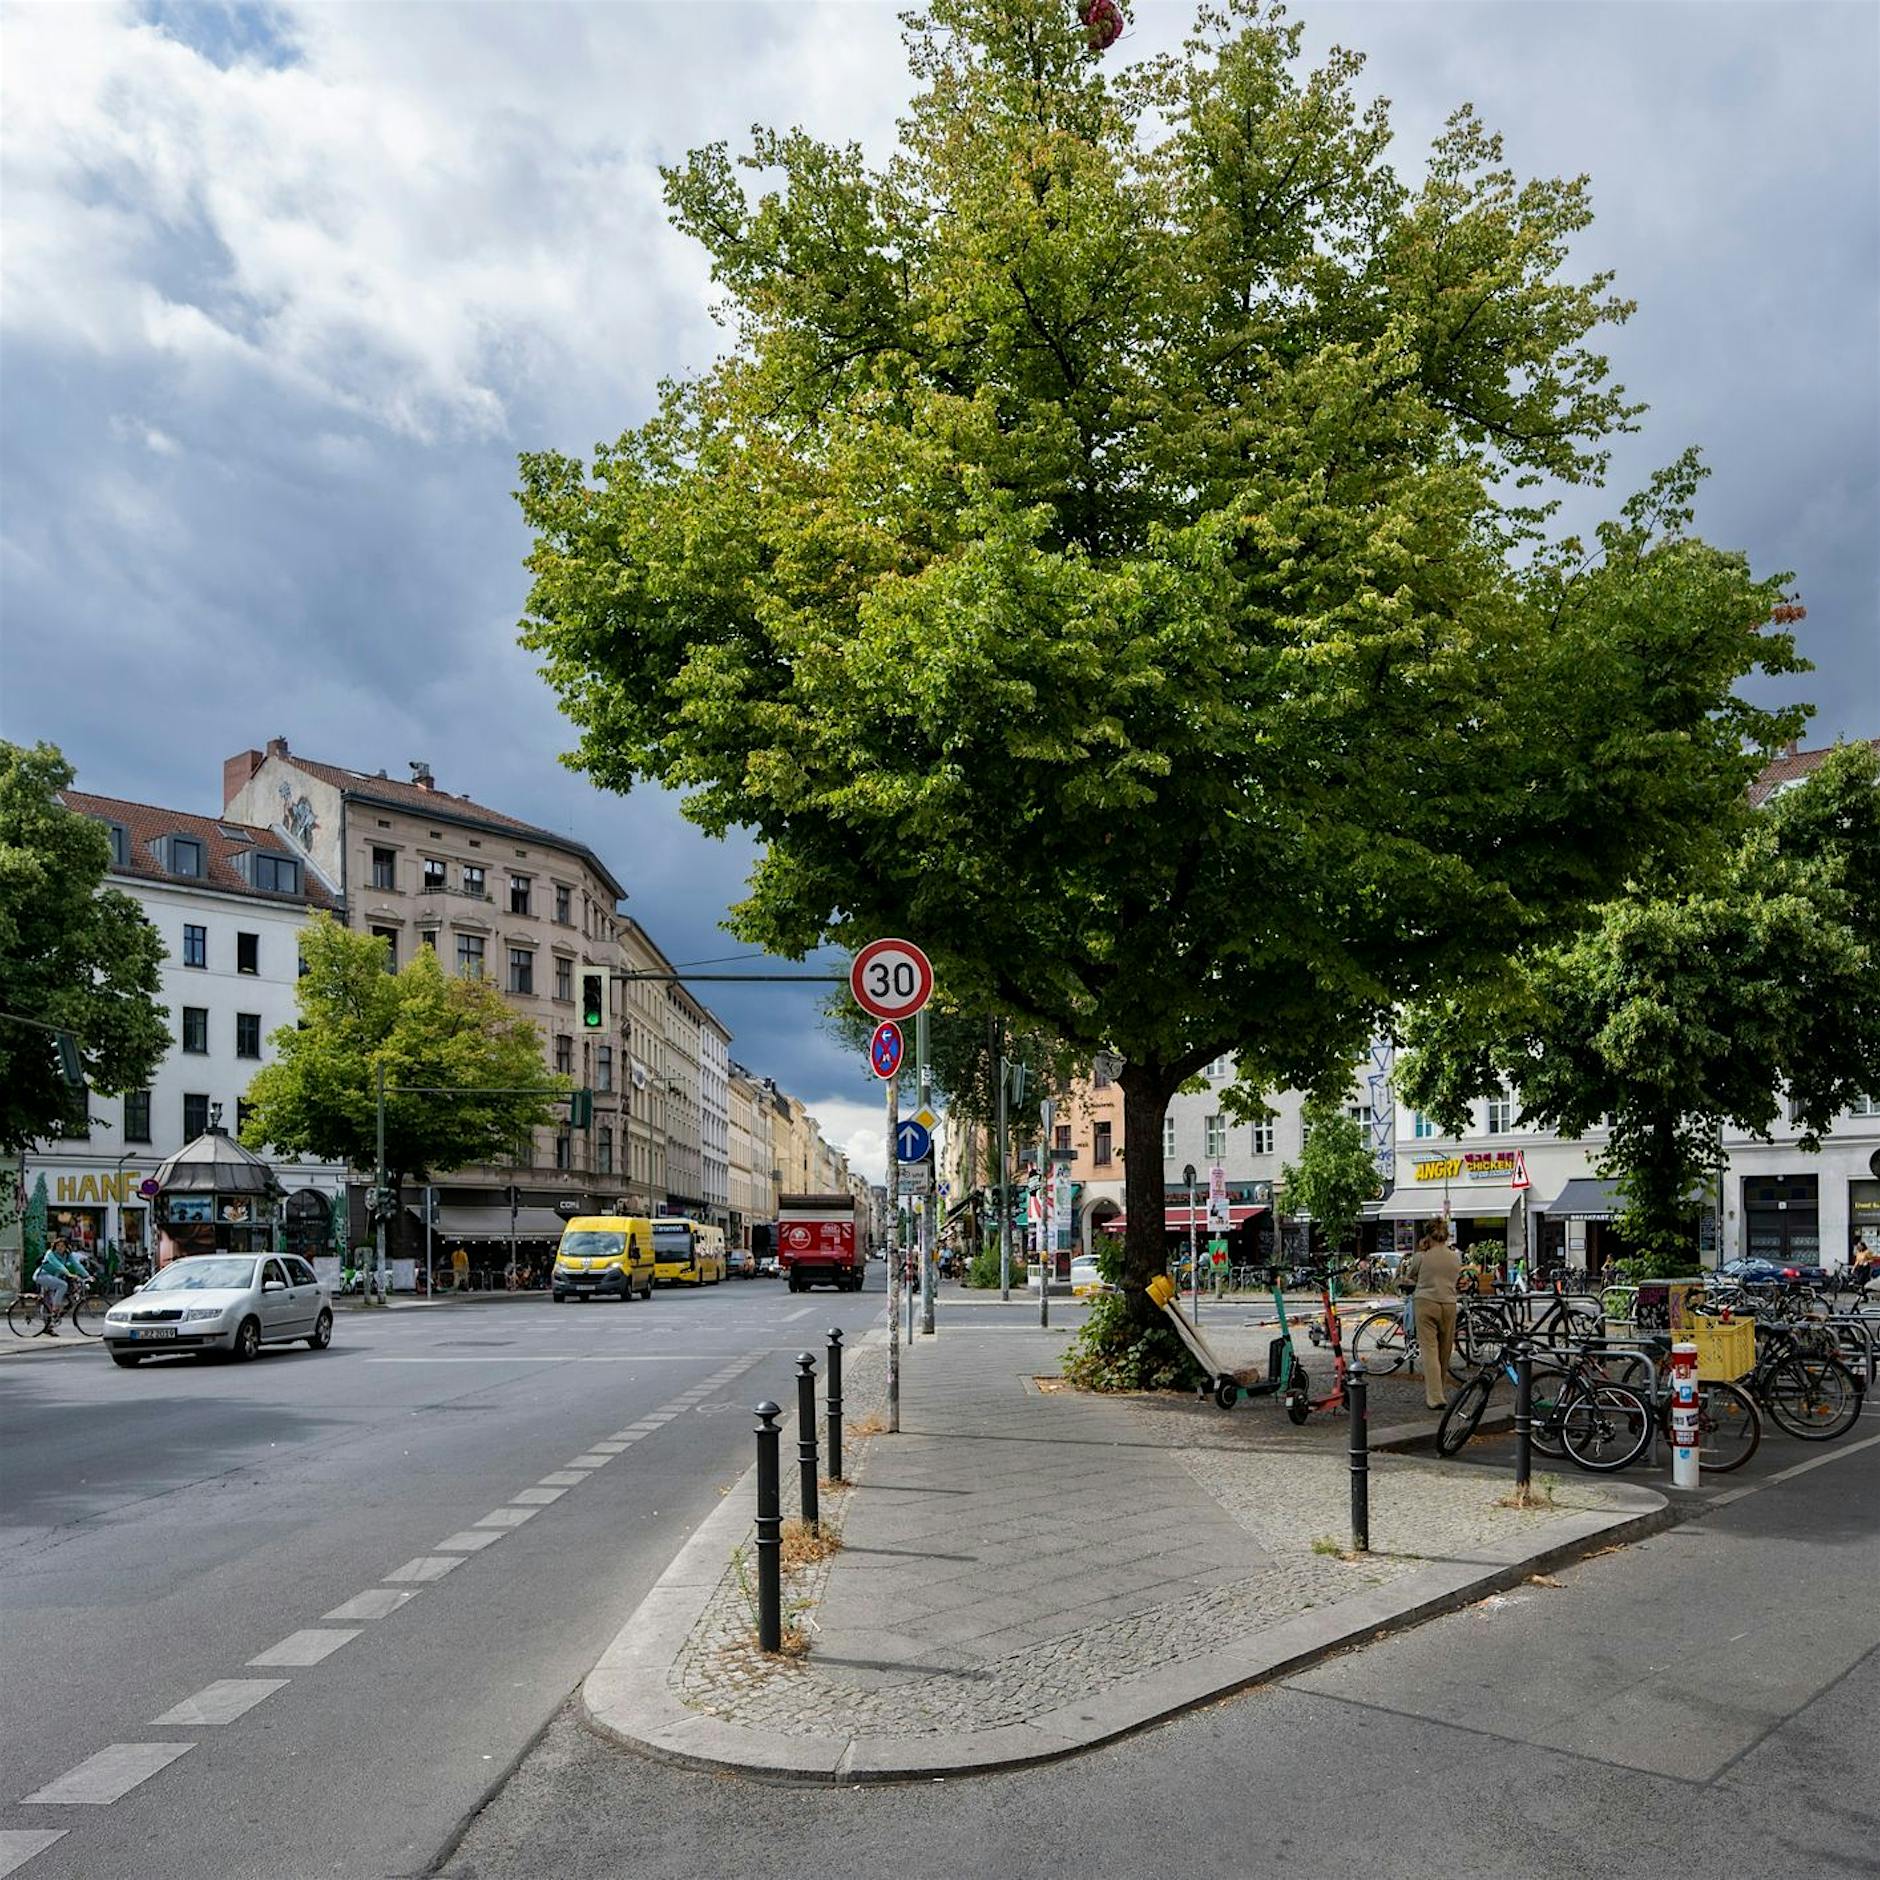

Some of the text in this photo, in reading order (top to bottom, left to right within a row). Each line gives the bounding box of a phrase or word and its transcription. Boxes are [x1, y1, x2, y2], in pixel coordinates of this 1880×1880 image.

[869, 962, 915, 998] 30
[1416, 1159, 1465, 1181] ANGRY
[1466, 1160, 1514, 1171] CHICKEN
[57, 1172, 141, 1202] HANF
[1570, 1213, 1610, 1221] BREAKFAST
